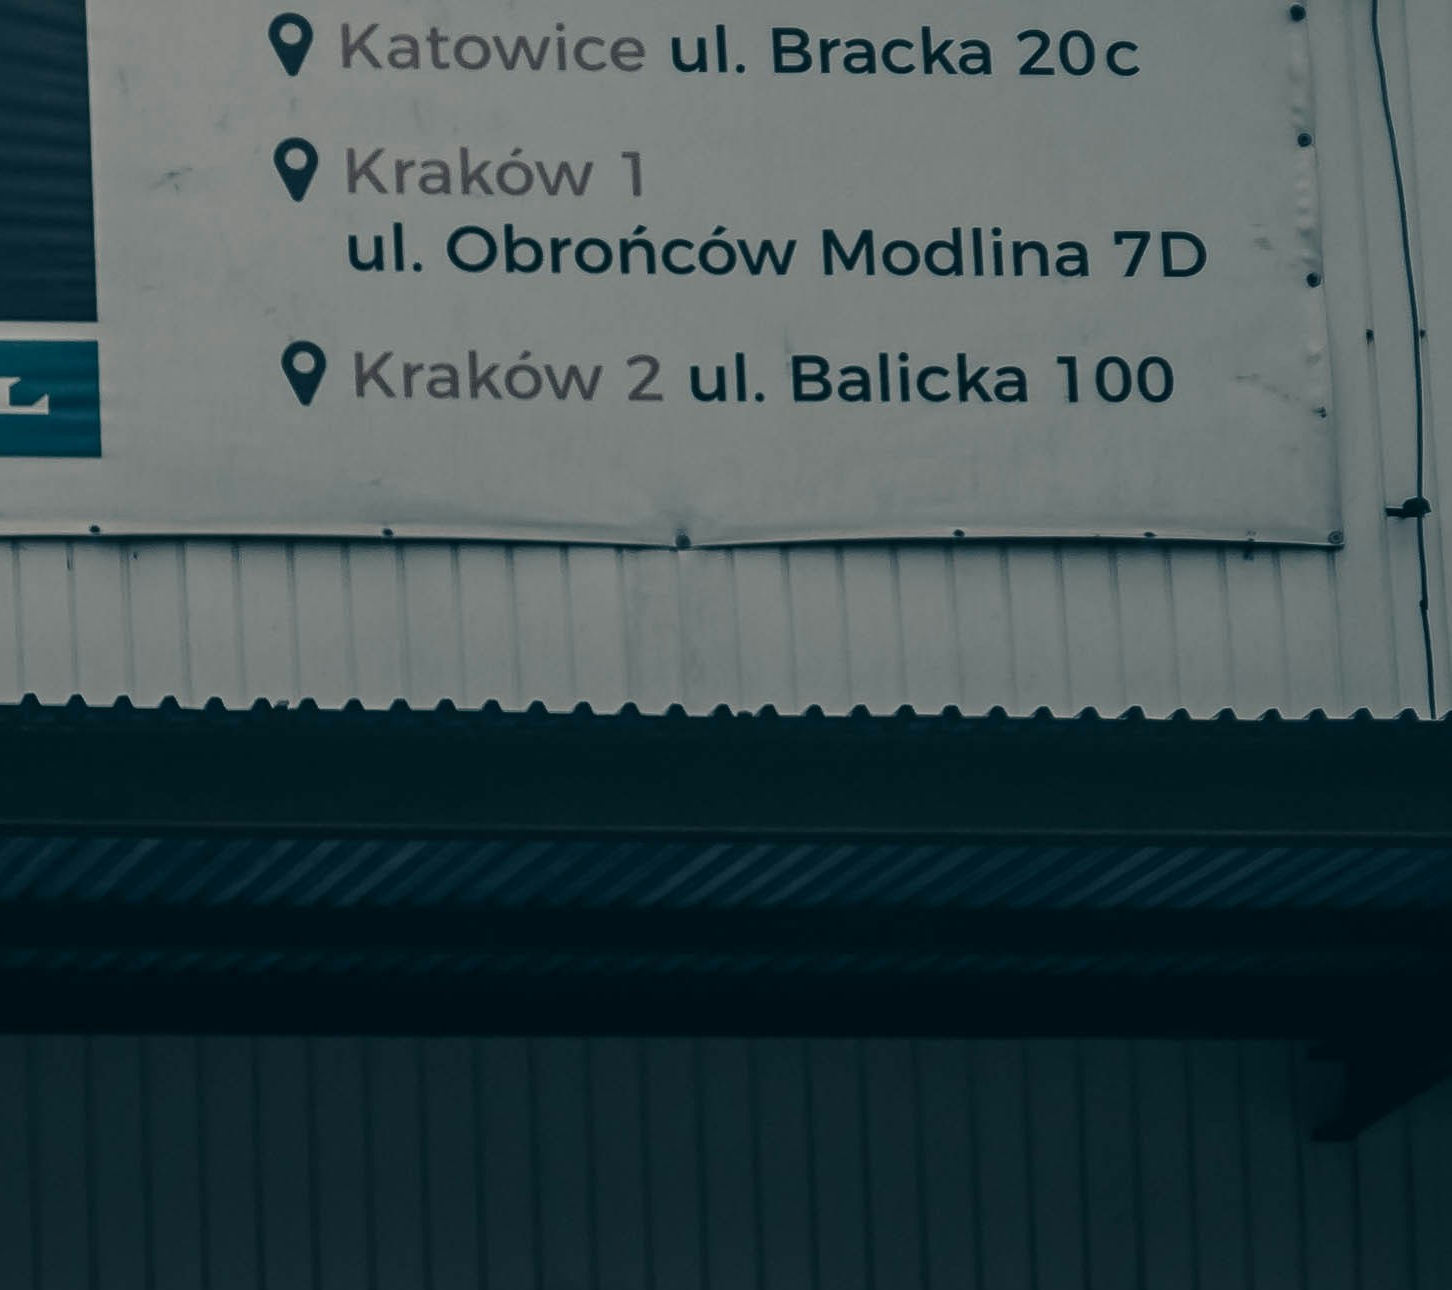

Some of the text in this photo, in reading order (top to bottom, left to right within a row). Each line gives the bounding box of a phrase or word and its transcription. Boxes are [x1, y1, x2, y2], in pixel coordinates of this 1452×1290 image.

[340, 22, 1141, 78] Katowice ul. Bracka 20c
[347, 146, 644, 198] Kraków 1
[348, 222, 1208, 279] ul. Obrońców Modlina 7D
[353, 349, 1175, 404] Kraków 2 ul. Balicka 100
